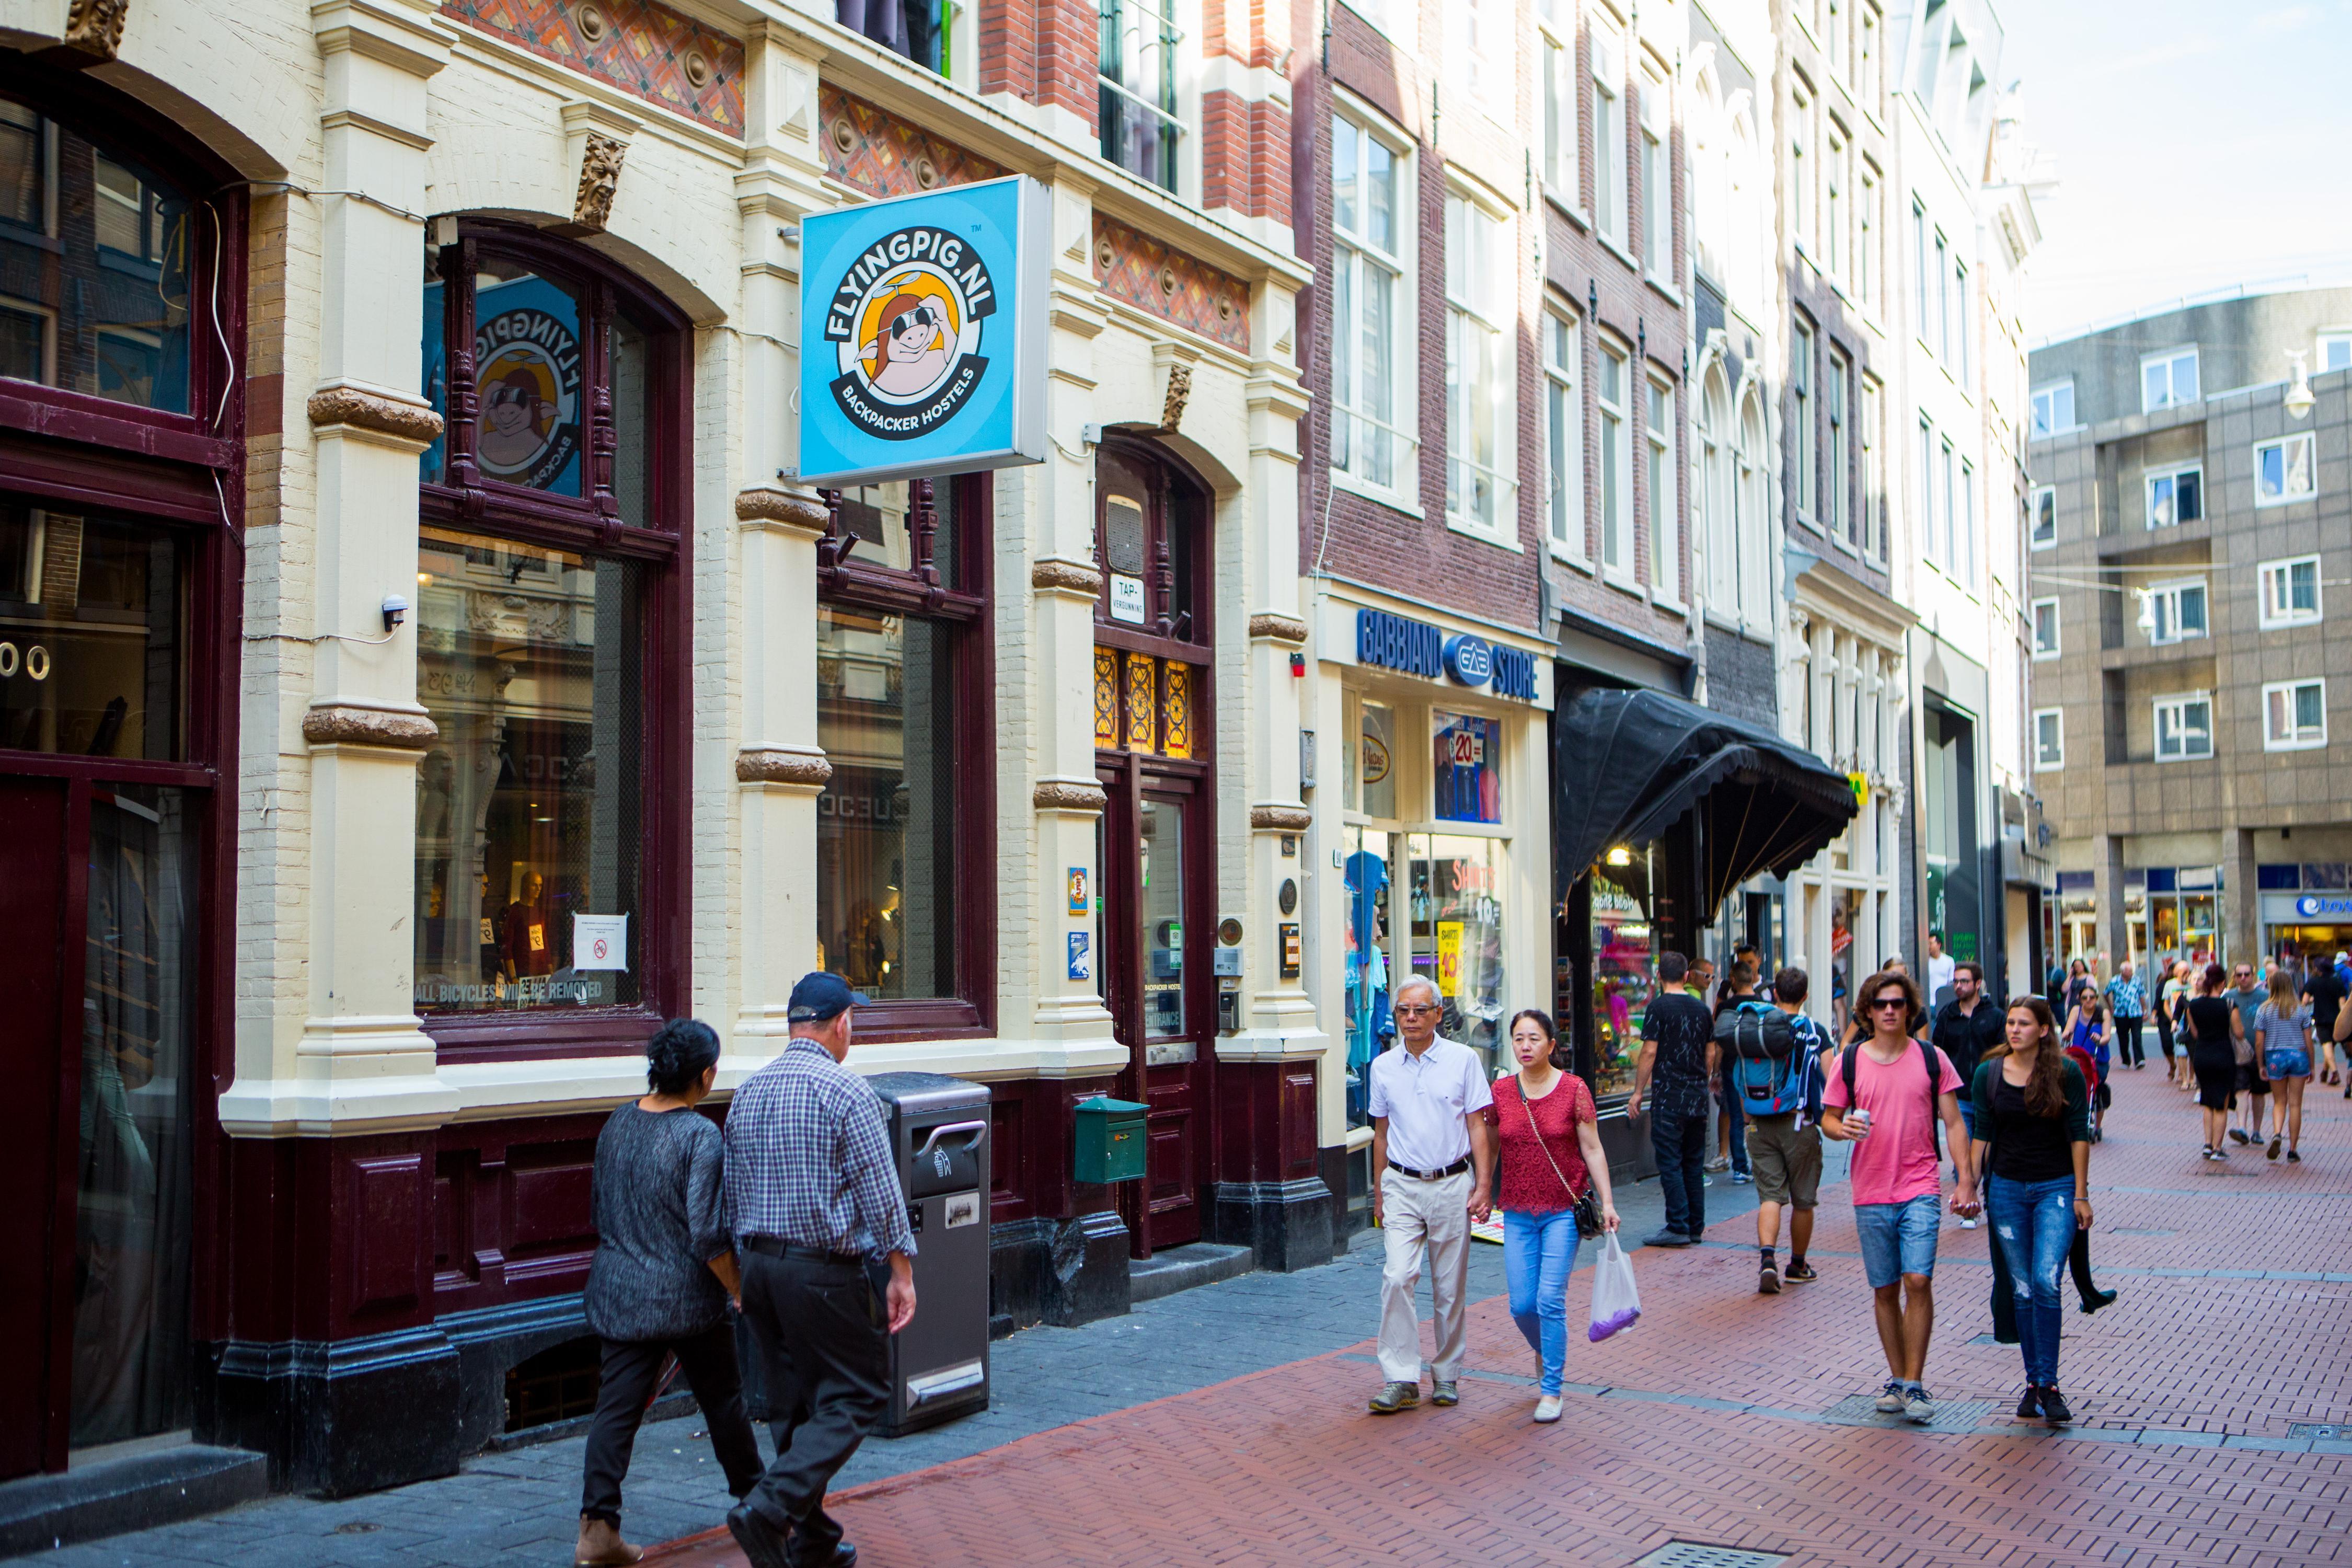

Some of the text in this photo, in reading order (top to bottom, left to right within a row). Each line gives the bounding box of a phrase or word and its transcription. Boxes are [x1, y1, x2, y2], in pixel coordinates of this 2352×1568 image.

[828, 230, 992, 336] FLYINGPIG.NL
[842, 367, 974, 432] BACKPACKER HOSTELS
[1113, 599, 1143, 613] VERGUNNING
[1357, 608, 1443, 678] GABBIANO
[1492, 644, 1539, 700] STORE
[414, 985, 435, 1002] ALL
[440, 985, 496, 1003] BICYCLES
[531, 983, 546, 1000] BE
[549, 981, 601, 999] REMOVED
[1145, 1011, 1180, 1027] ENTRANCE
